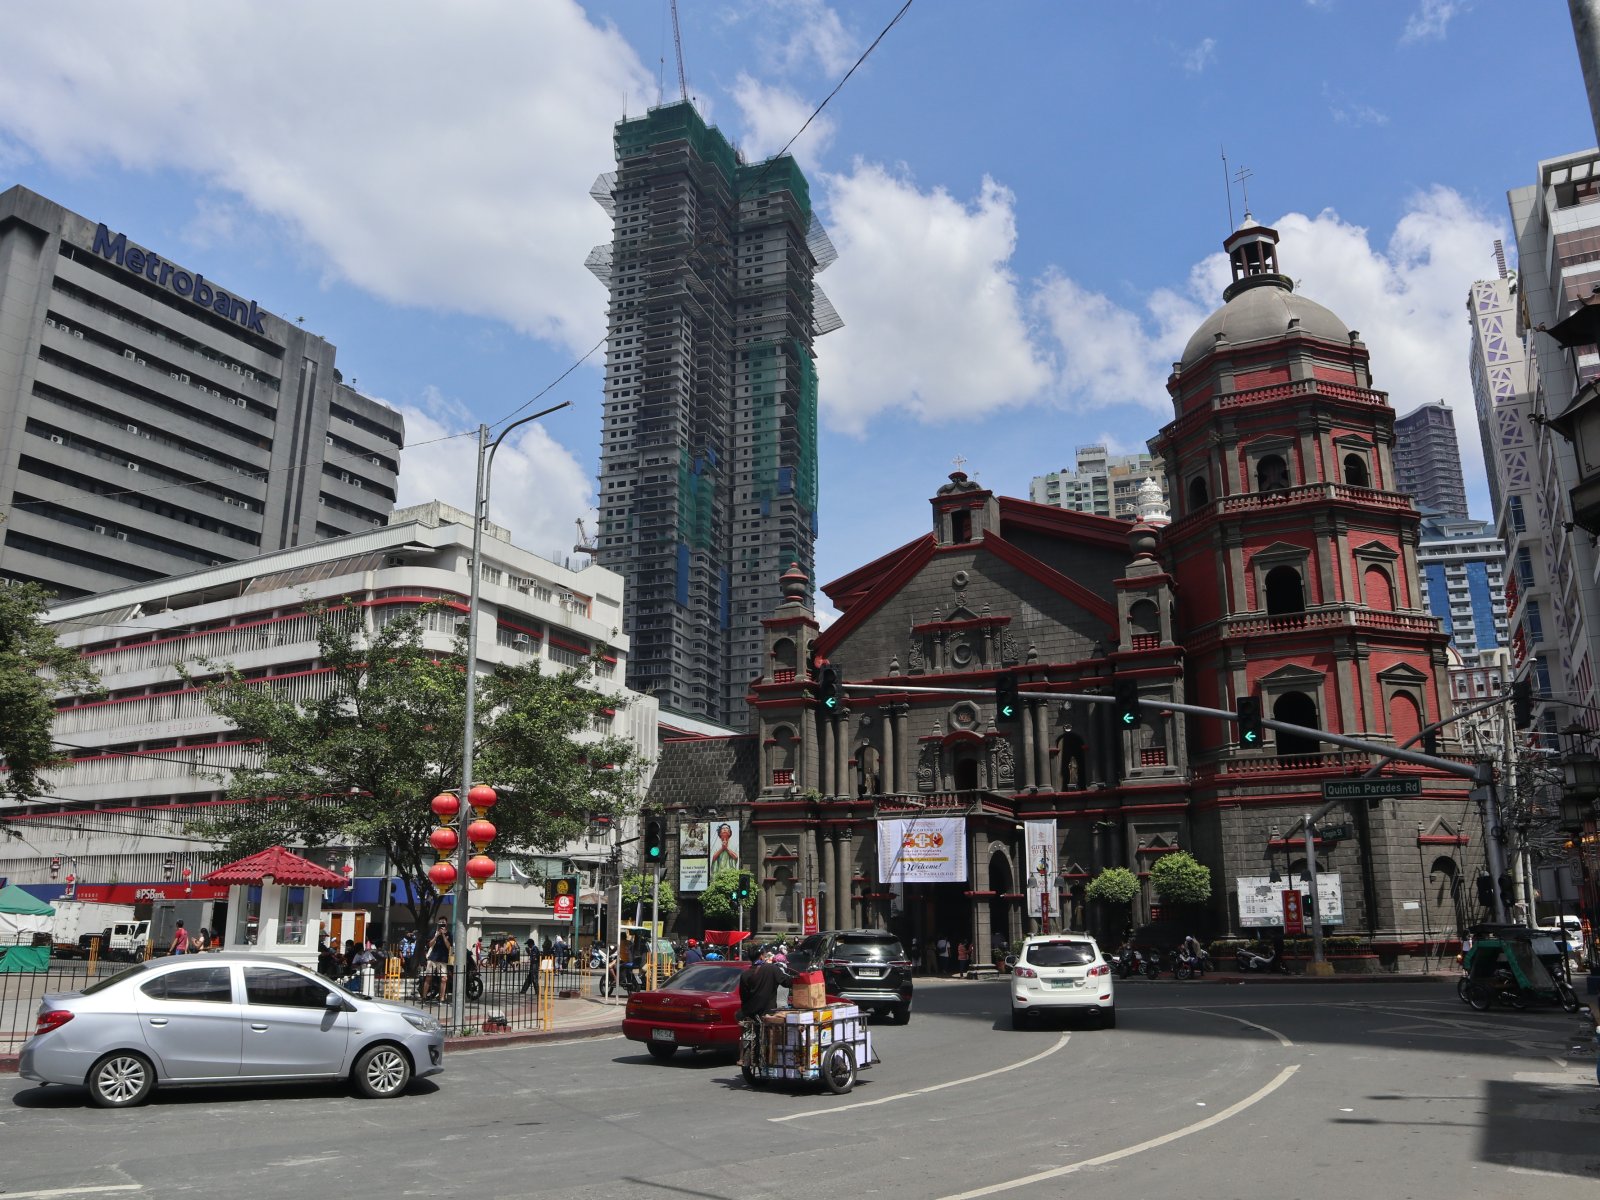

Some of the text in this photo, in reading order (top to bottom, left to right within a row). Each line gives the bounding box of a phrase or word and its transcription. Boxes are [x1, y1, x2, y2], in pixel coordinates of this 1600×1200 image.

[92, 223, 266, 334] Metrobank
[1327, 782, 1418, 795] Quintin Paredes Rd
[903, 862, 942, 872] Welcome!
[141, 888, 165, 899] PSBank
